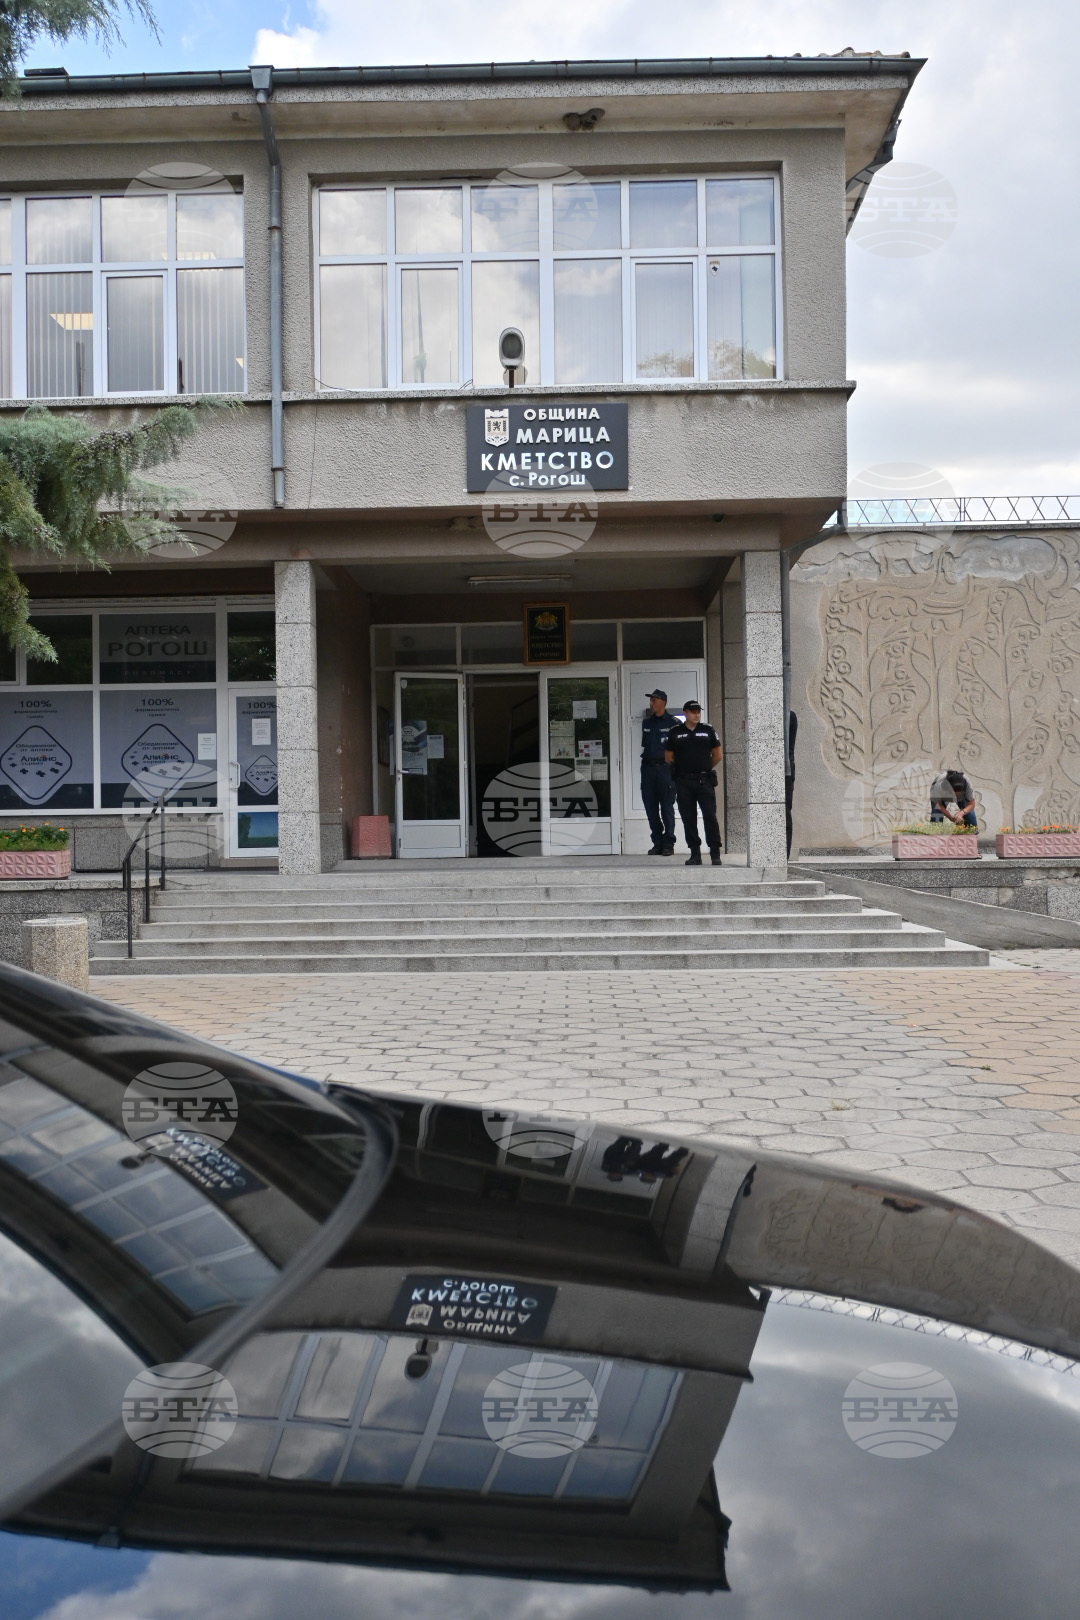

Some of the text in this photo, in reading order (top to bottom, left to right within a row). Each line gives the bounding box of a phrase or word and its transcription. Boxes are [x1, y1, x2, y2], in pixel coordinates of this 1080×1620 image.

[523, 407, 600, 422] ОБЩИНА
[515, 426, 611, 445] МАРИЦА
[481, 450, 614, 471] КМЕТСТВО
[528, 472, 586, 487] Рогош
[124, 624, 192, 636] АПТЕКА
[107, 641, 208, 657] РОГОШ
[19, 700, 53, 708] 100%
[141, 698, 174, 706] 100%
[247, 701, 277, 709] 100%
[20, 755, 57, 763] Алианс
[142, 753, 180, 761] Алианс
